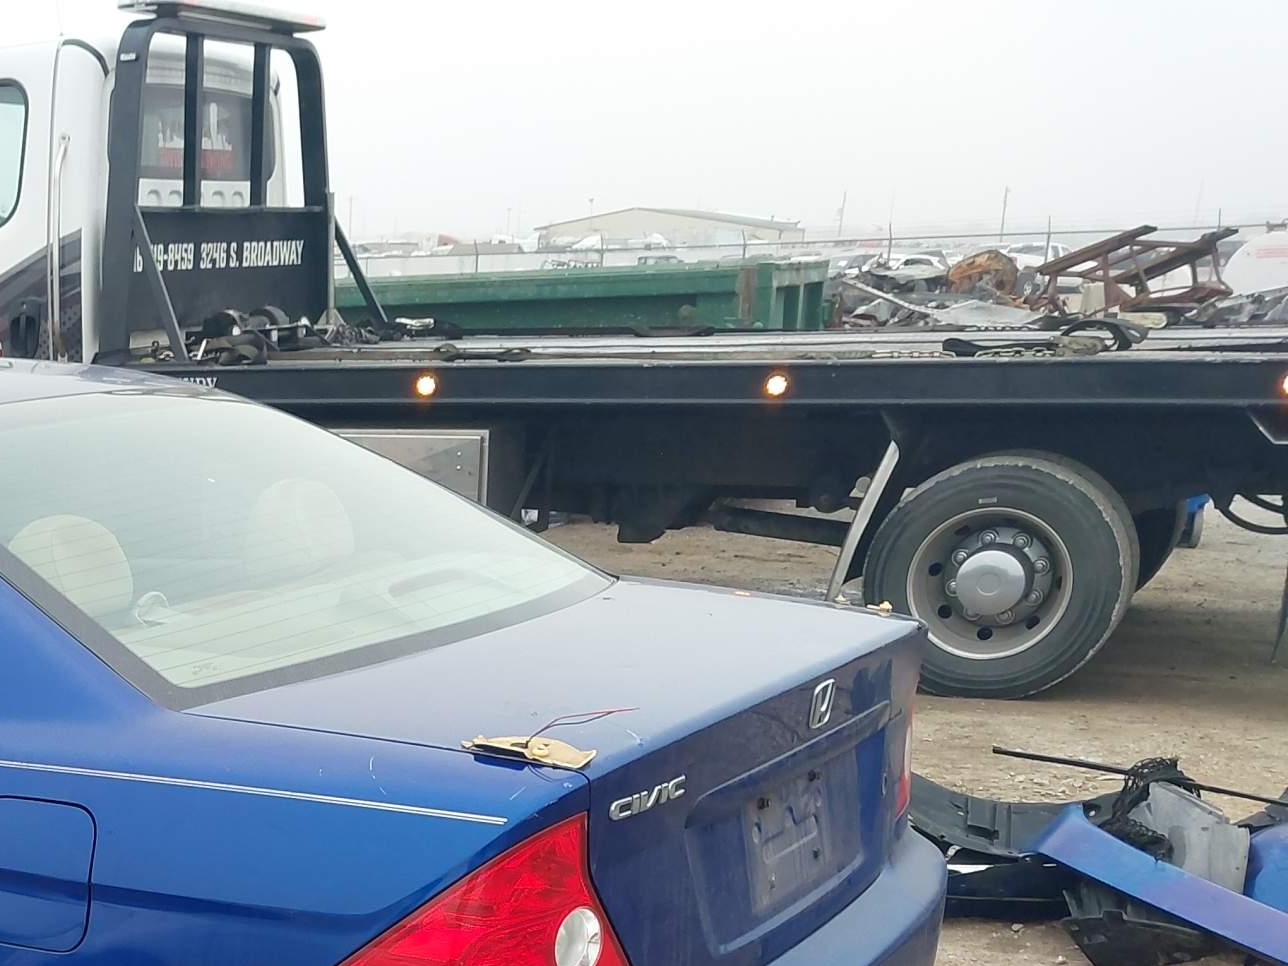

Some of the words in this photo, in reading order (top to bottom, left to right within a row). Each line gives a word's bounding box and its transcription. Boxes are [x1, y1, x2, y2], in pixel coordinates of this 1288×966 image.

[151, 242, 195, 272] 19-8459
[199, 241, 227, 269] 3246
[229, 241, 239, 268] S.
[242, 239, 304, 268] BROADWAY
[609, 775, 686, 820] CIVIC
